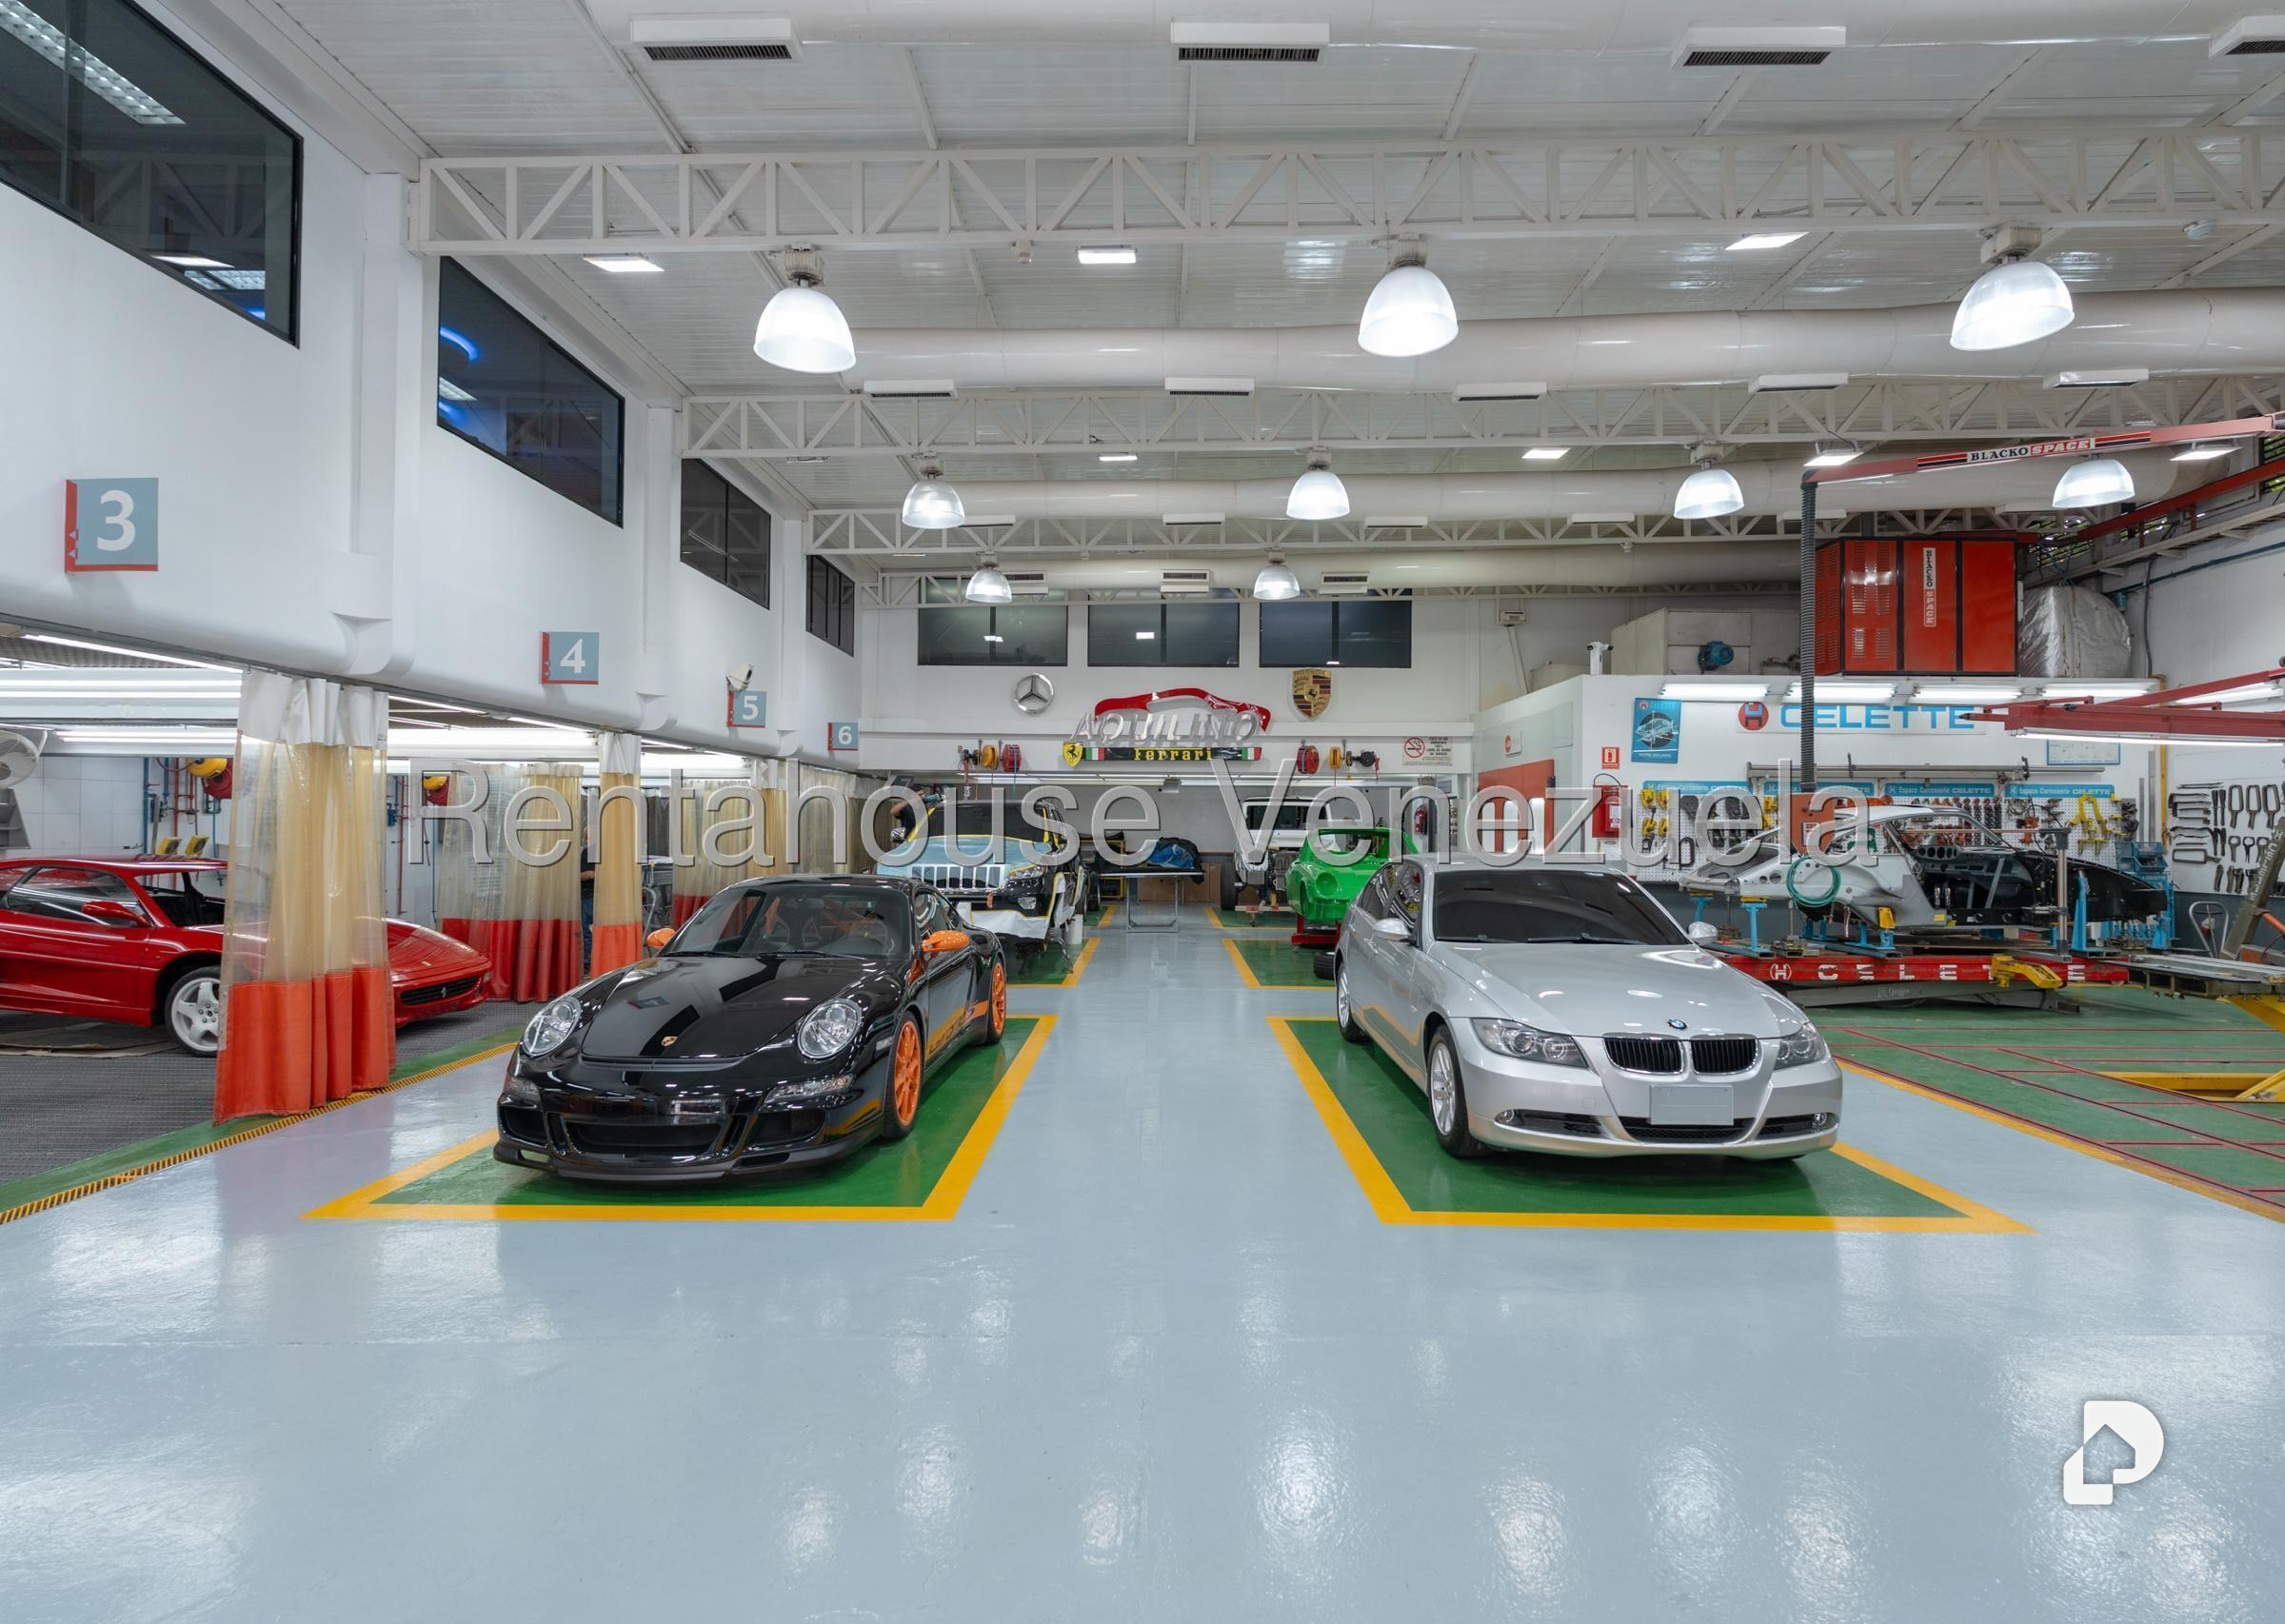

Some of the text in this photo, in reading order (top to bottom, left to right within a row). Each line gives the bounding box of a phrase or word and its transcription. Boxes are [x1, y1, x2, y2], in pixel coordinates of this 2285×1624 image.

[1971, 439, 2090, 462] BLACKO SPACE
[97, 489, 136, 551] 3
[1925, 549, 1935, 624] BLACKO SPACE
[560, 638, 586, 674] 4
[742, 695, 759, 721] 5
[1780, 704, 1975, 729] CELETTE
[837, 725, 853, 745] 6
[1071, 712, 1257, 744] AQUILINO
[1134, 747, 1212, 761] Ferrari
[1898, 785, 1917, 795] Espace
[2018, 785, 2037, 795] Espace
[2039, 786, 2070, 795] Carrosserie
[1818, 963, 2086, 980] CELETE
